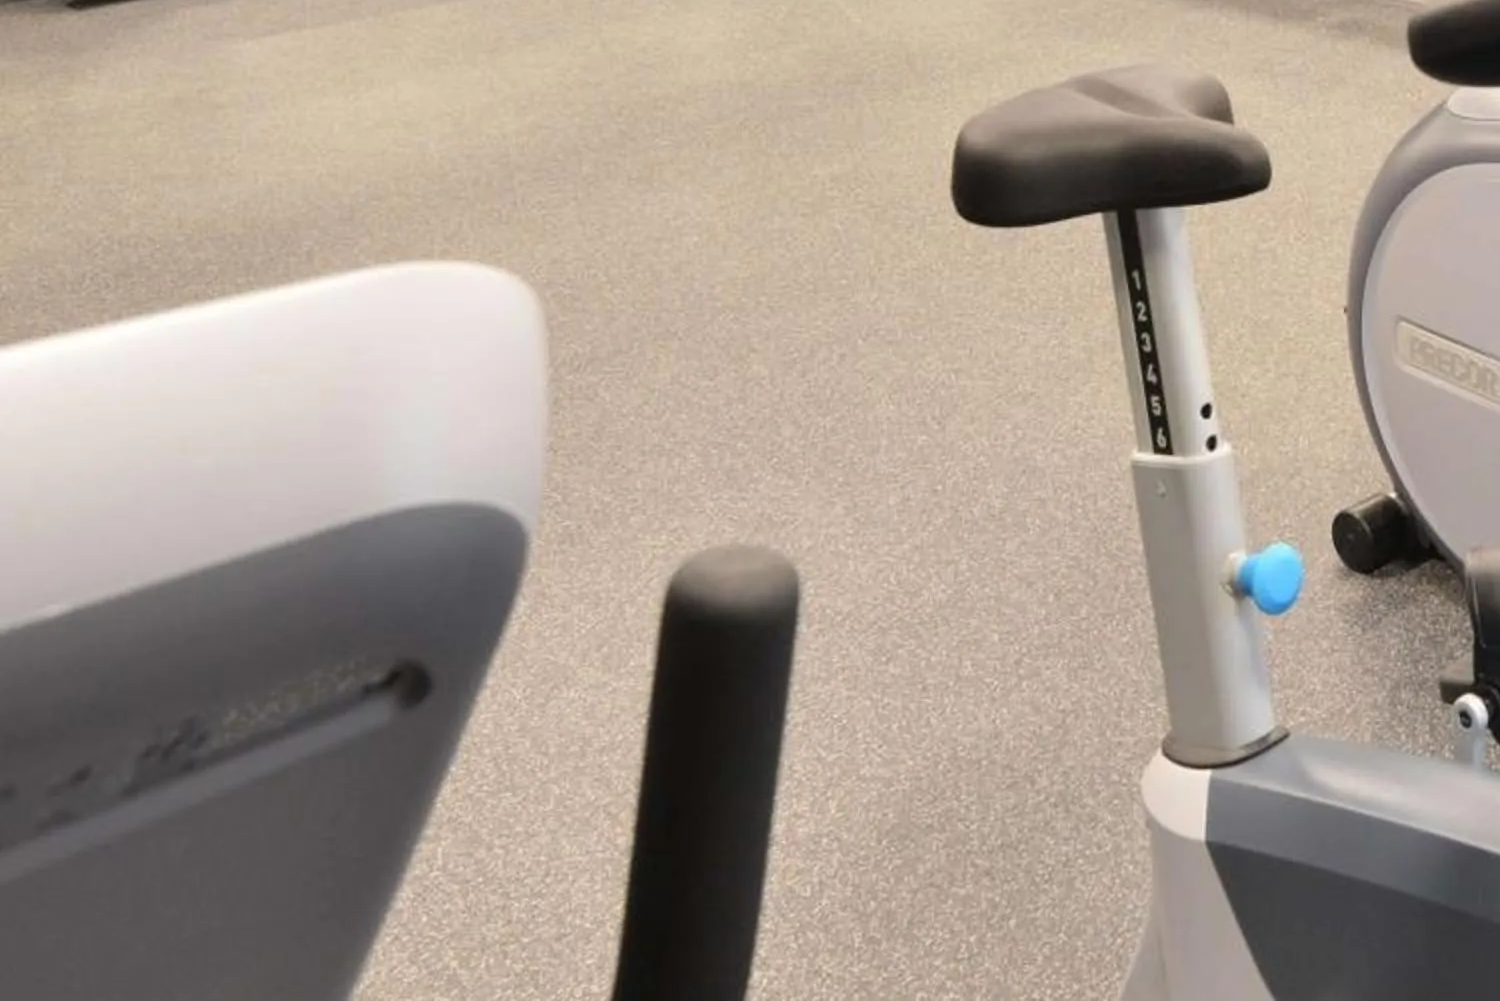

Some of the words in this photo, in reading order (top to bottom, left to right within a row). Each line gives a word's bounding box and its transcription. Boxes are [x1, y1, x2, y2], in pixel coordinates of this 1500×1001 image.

[1132, 269, 1142, 291] 1
[1136, 301, 1148, 322] 2
[1141, 333, 1152, 353] 3
[1147, 363, 1158, 383] 4
[1151, 396, 1162, 416] 5
[1157, 427, 1167, 448] 6
